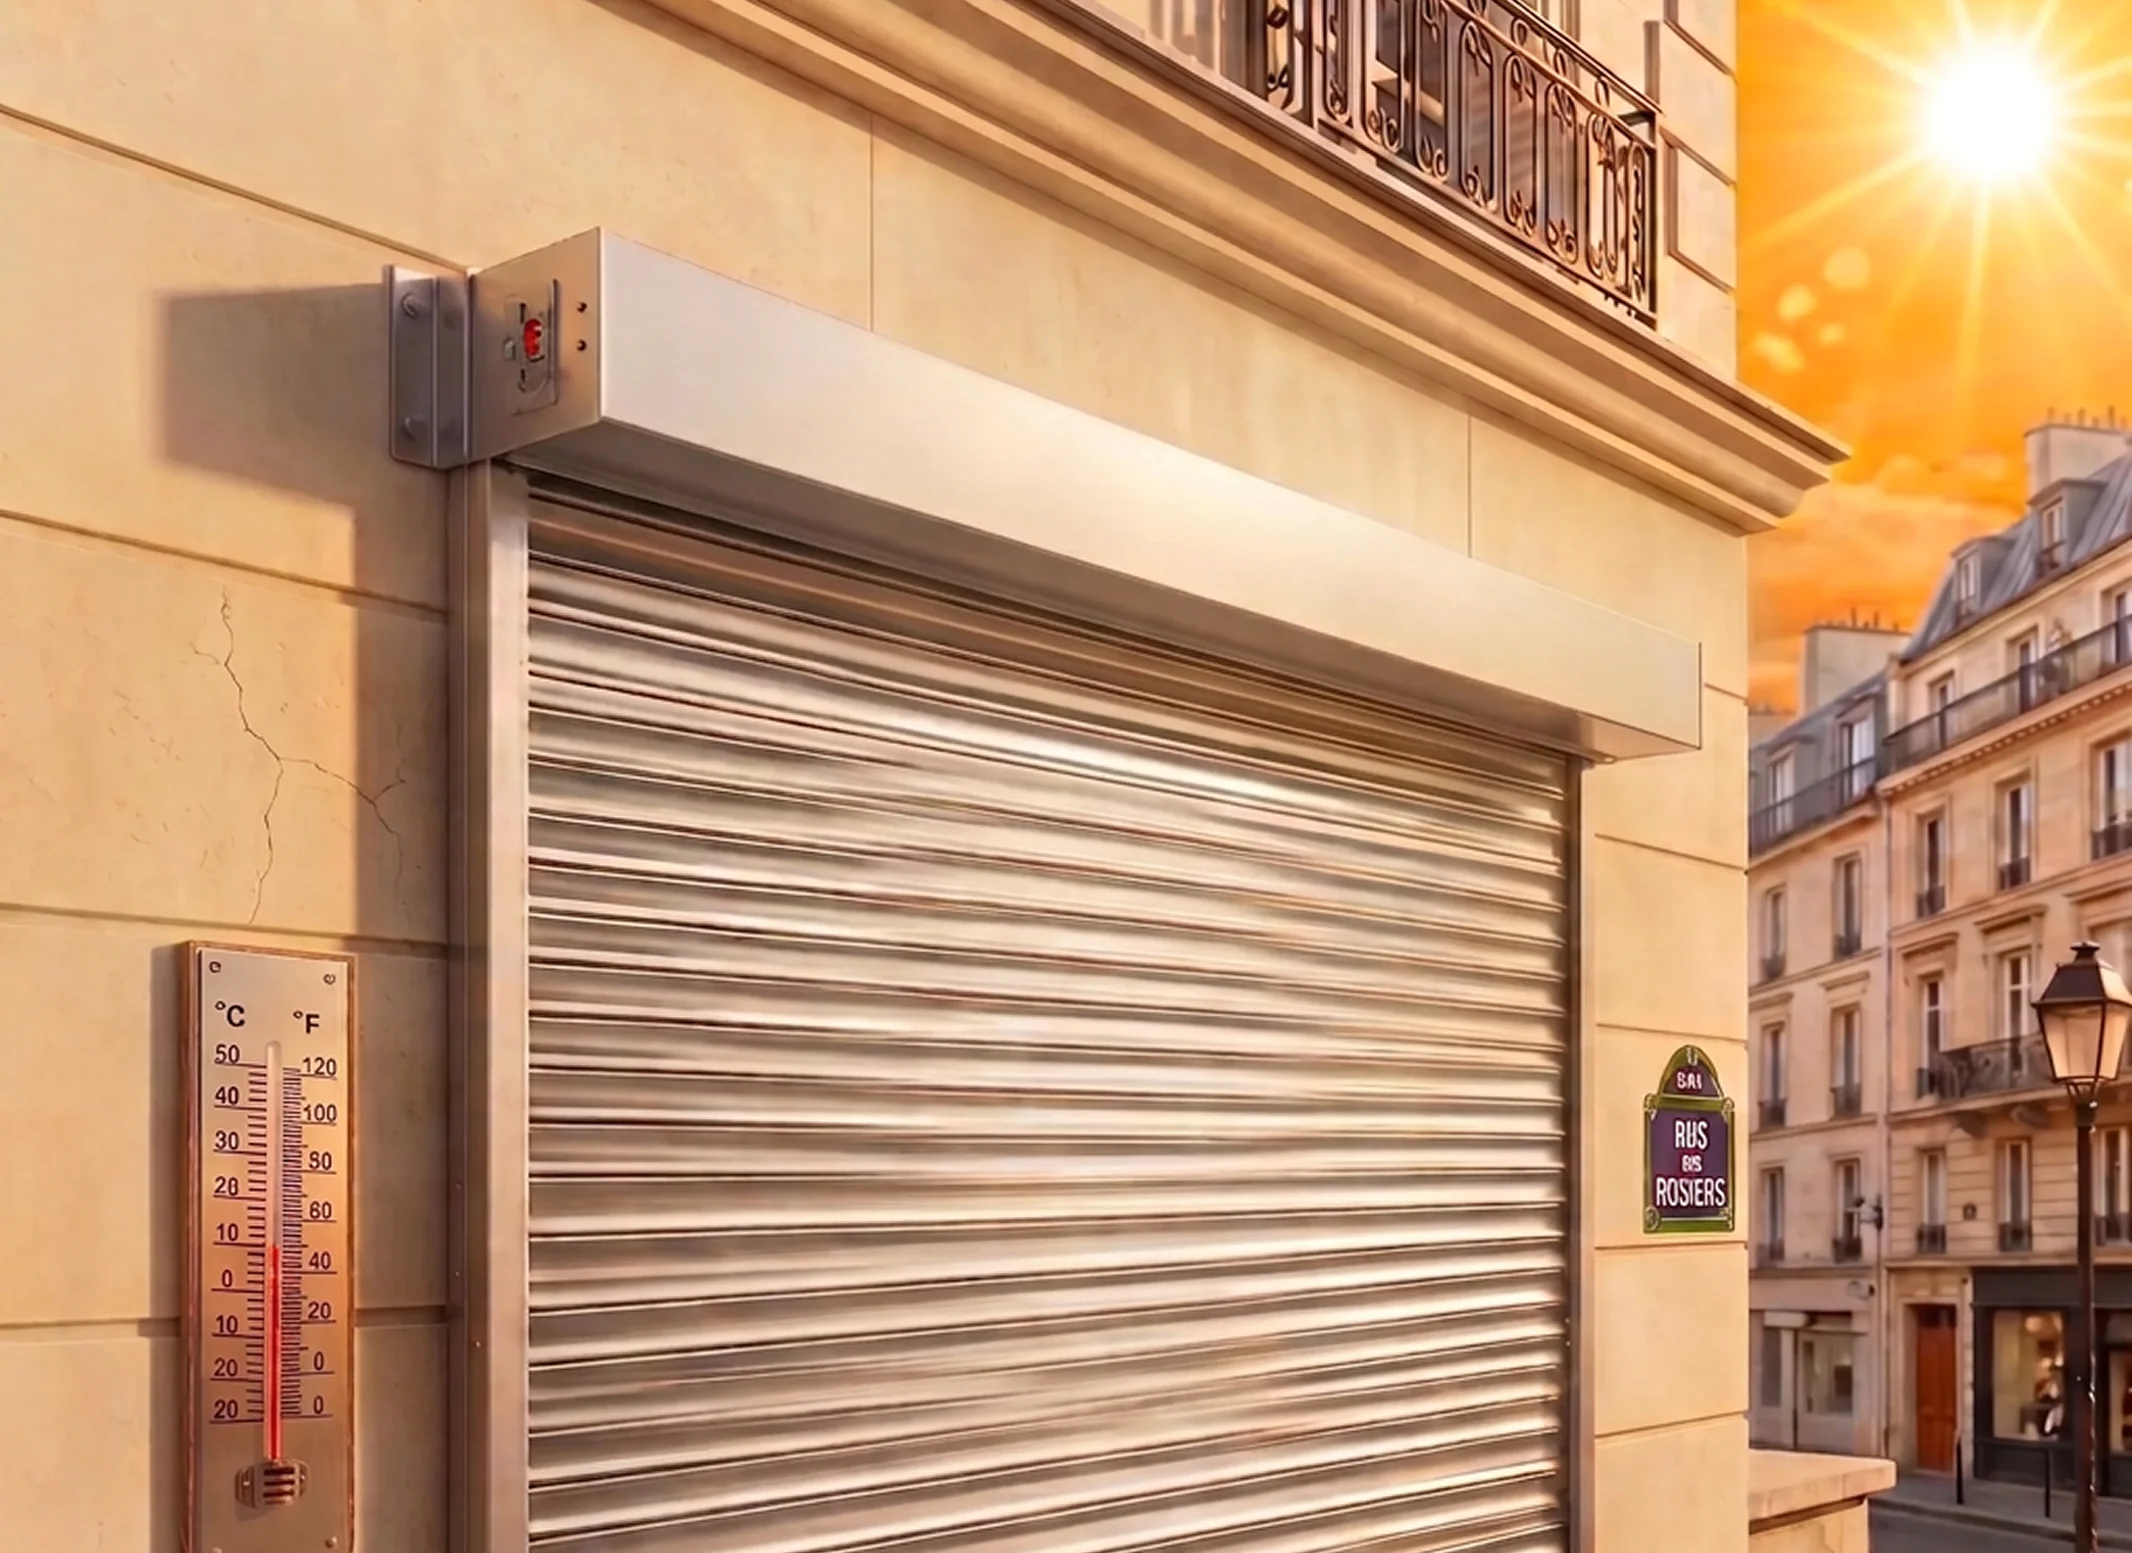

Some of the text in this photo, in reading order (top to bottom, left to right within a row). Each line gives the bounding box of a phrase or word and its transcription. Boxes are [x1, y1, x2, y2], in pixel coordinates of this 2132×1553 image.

[214, 1044, 240, 1064] 50
[303, 1057, 337, 1076] 120
[215, 1086, 239, 1105] 40
[303, 1104, 337, 1123] 100
[215, 1130, 239, 1150] 30
[1656, 1177, 1726, 1207] ROSIERS
[309, 1201, 332, 1219] 60
[216, 1223, 239, 1241] 10
[309, 1251, 331, 1270] 40
[222, 1269, 232, 1287] 0
[308, 1301, 331, 1319] 20
[216, 1315, 238, 1334] 10
[214, 1357, 238, 1377] 20
[313, 1351, 324, 1370] 0
[213, 1399, 238, 1419] 20
[313, 1395, 324, 1414] 0
